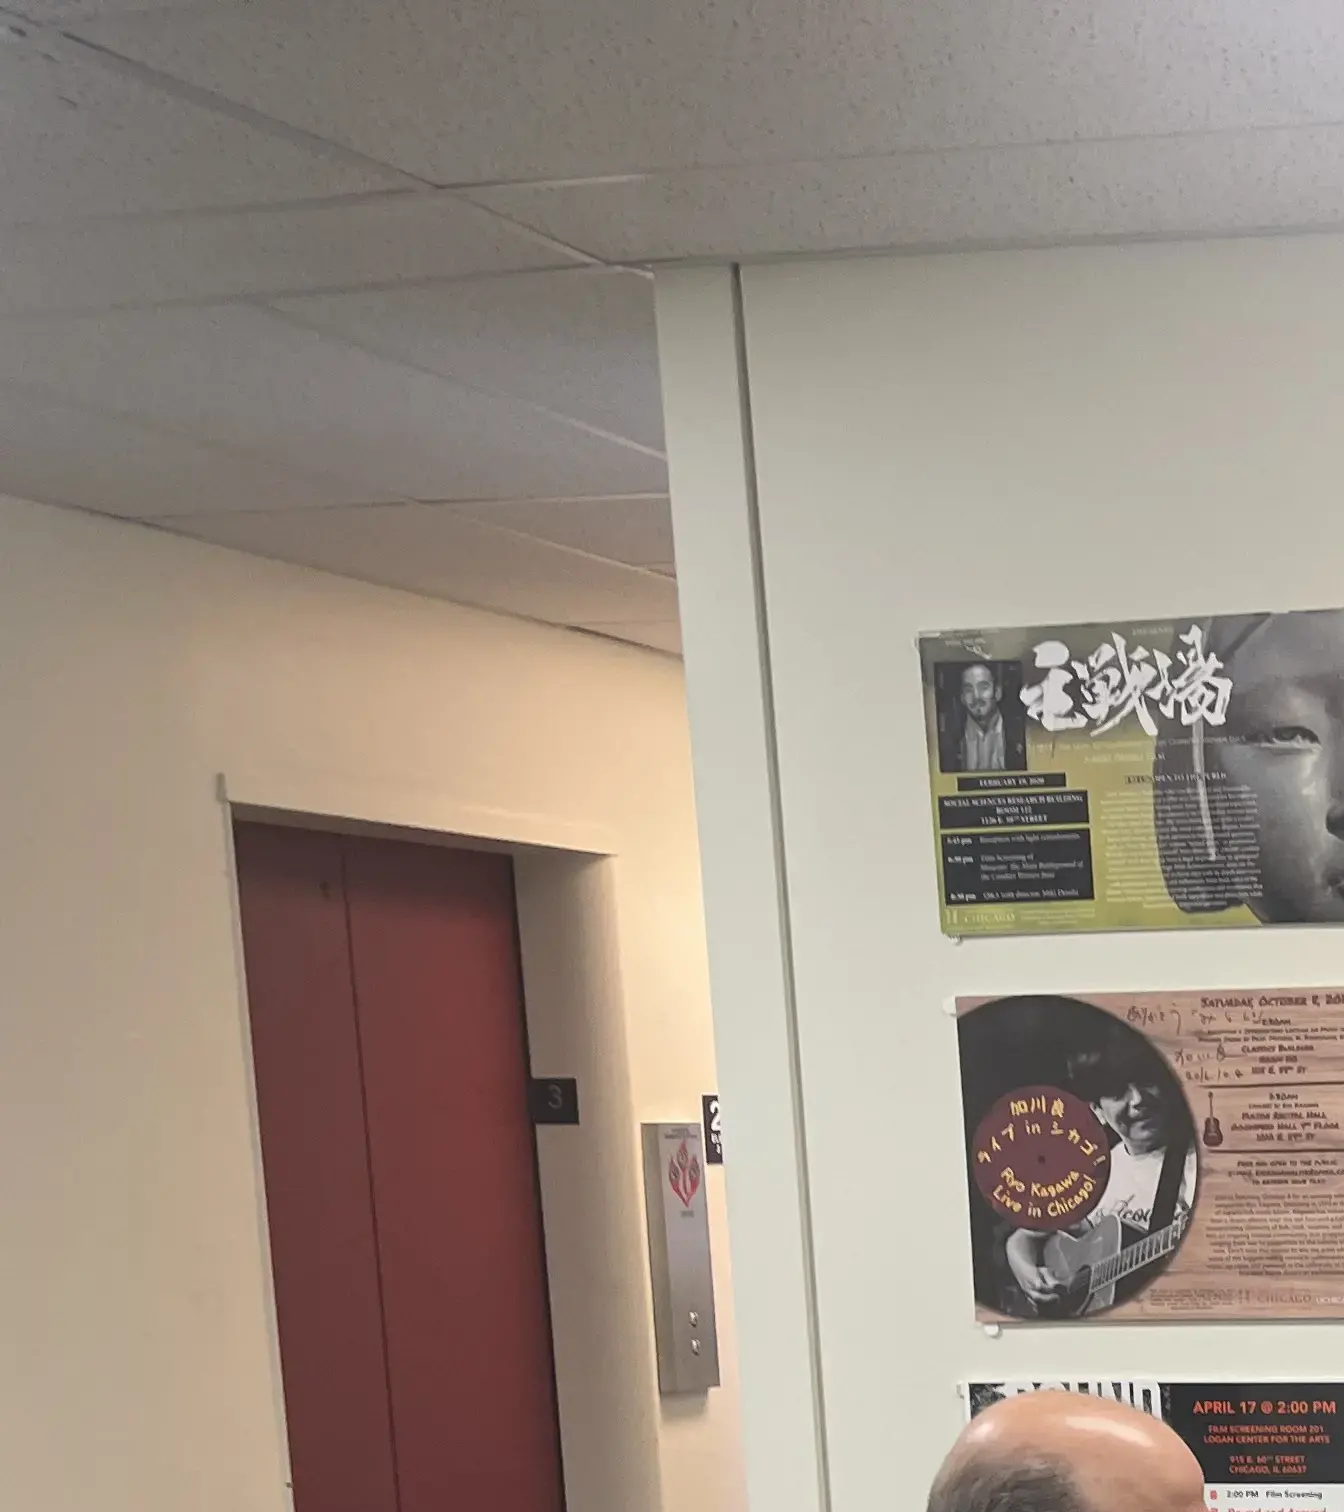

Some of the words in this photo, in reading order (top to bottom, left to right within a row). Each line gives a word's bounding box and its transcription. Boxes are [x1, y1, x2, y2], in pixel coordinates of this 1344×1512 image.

[548, 1084, 562, 1109] 3
[1193, 1400, 1236, 1415] APRIL
[1241, 1401, 1256, 1414] 17
[1260, 1400, 1274, 1414] @
[1277, 1400, 1308, 1414] 2:00
[1313, 1400, 1337, 1414] PM
